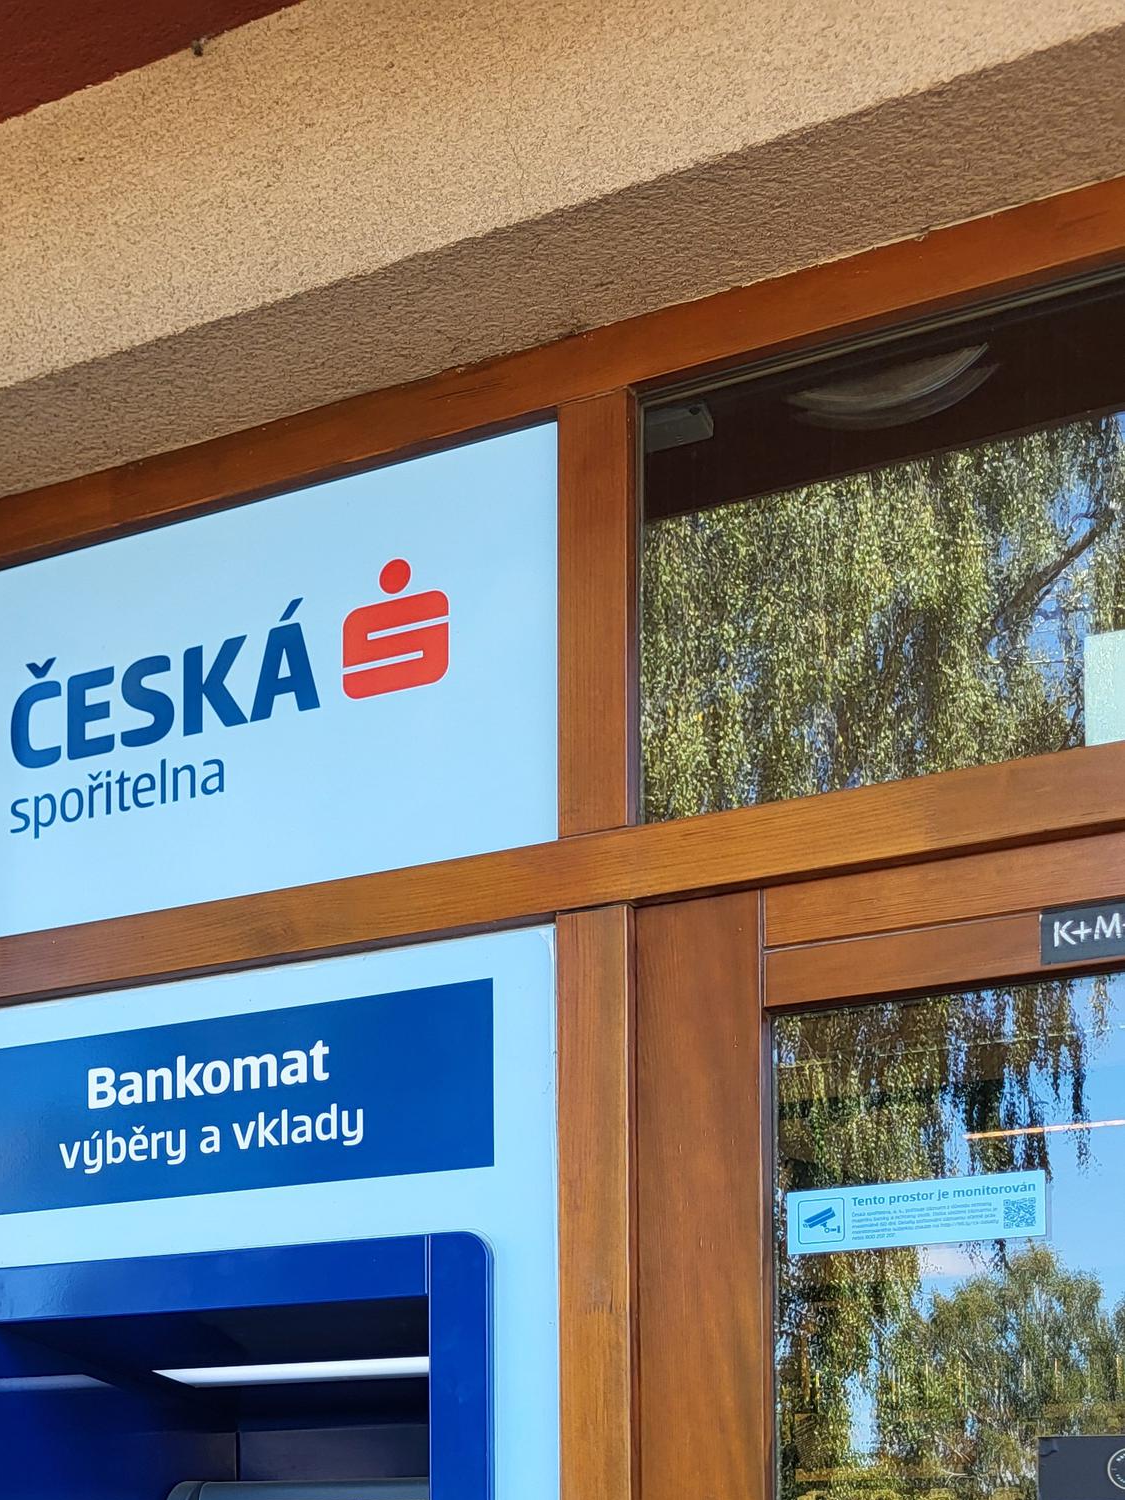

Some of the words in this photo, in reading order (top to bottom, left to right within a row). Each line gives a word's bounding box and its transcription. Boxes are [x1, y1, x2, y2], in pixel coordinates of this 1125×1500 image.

[10, 597, 321, 769] ČESKÁ
[10, 757, 226, 839] spořitelna
[1053, 912, 1125, 948] K+M
[86, 1040, 330, 1110] Bankomat
[59, 1124, 186, 1174] výběry
[200, 1126, 221, 1153] a
[233, 1103, 365, 1147] vklady
[852, 1195, 886, 1207] Tento
[888, 1189, 935, 1206] prostor
[937, 1186, 950, 1202] je
[952, 1181, 1036, 1199] monitorován
